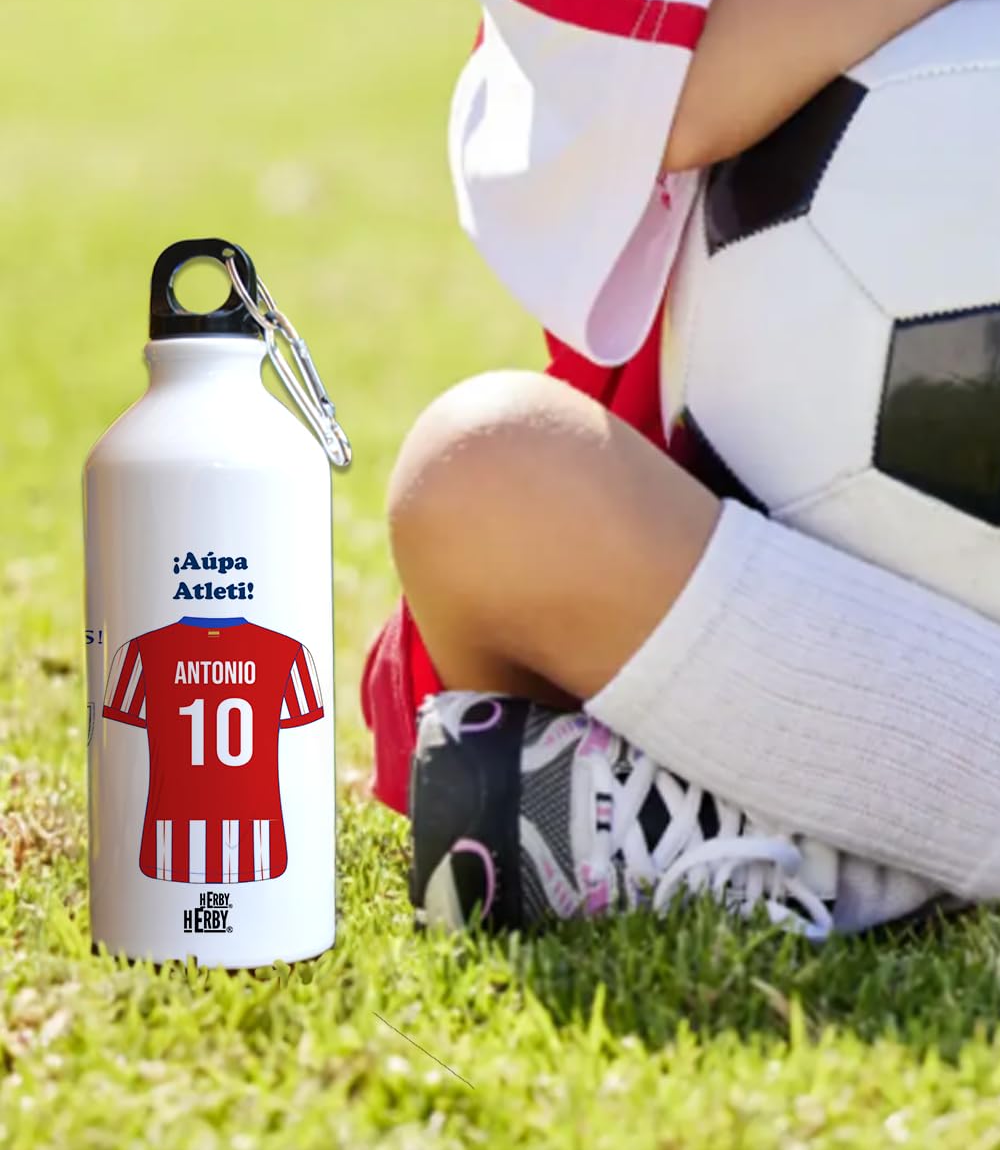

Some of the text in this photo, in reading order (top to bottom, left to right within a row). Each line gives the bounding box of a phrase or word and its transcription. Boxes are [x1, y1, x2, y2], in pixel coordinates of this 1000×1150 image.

[173, 551, 249, 575] ¡Aúpa
[172, 581, 254, 600] Atleti!
[174, 660, 257, 685] ANTONIO
[179, 697, 253, 767] 10
